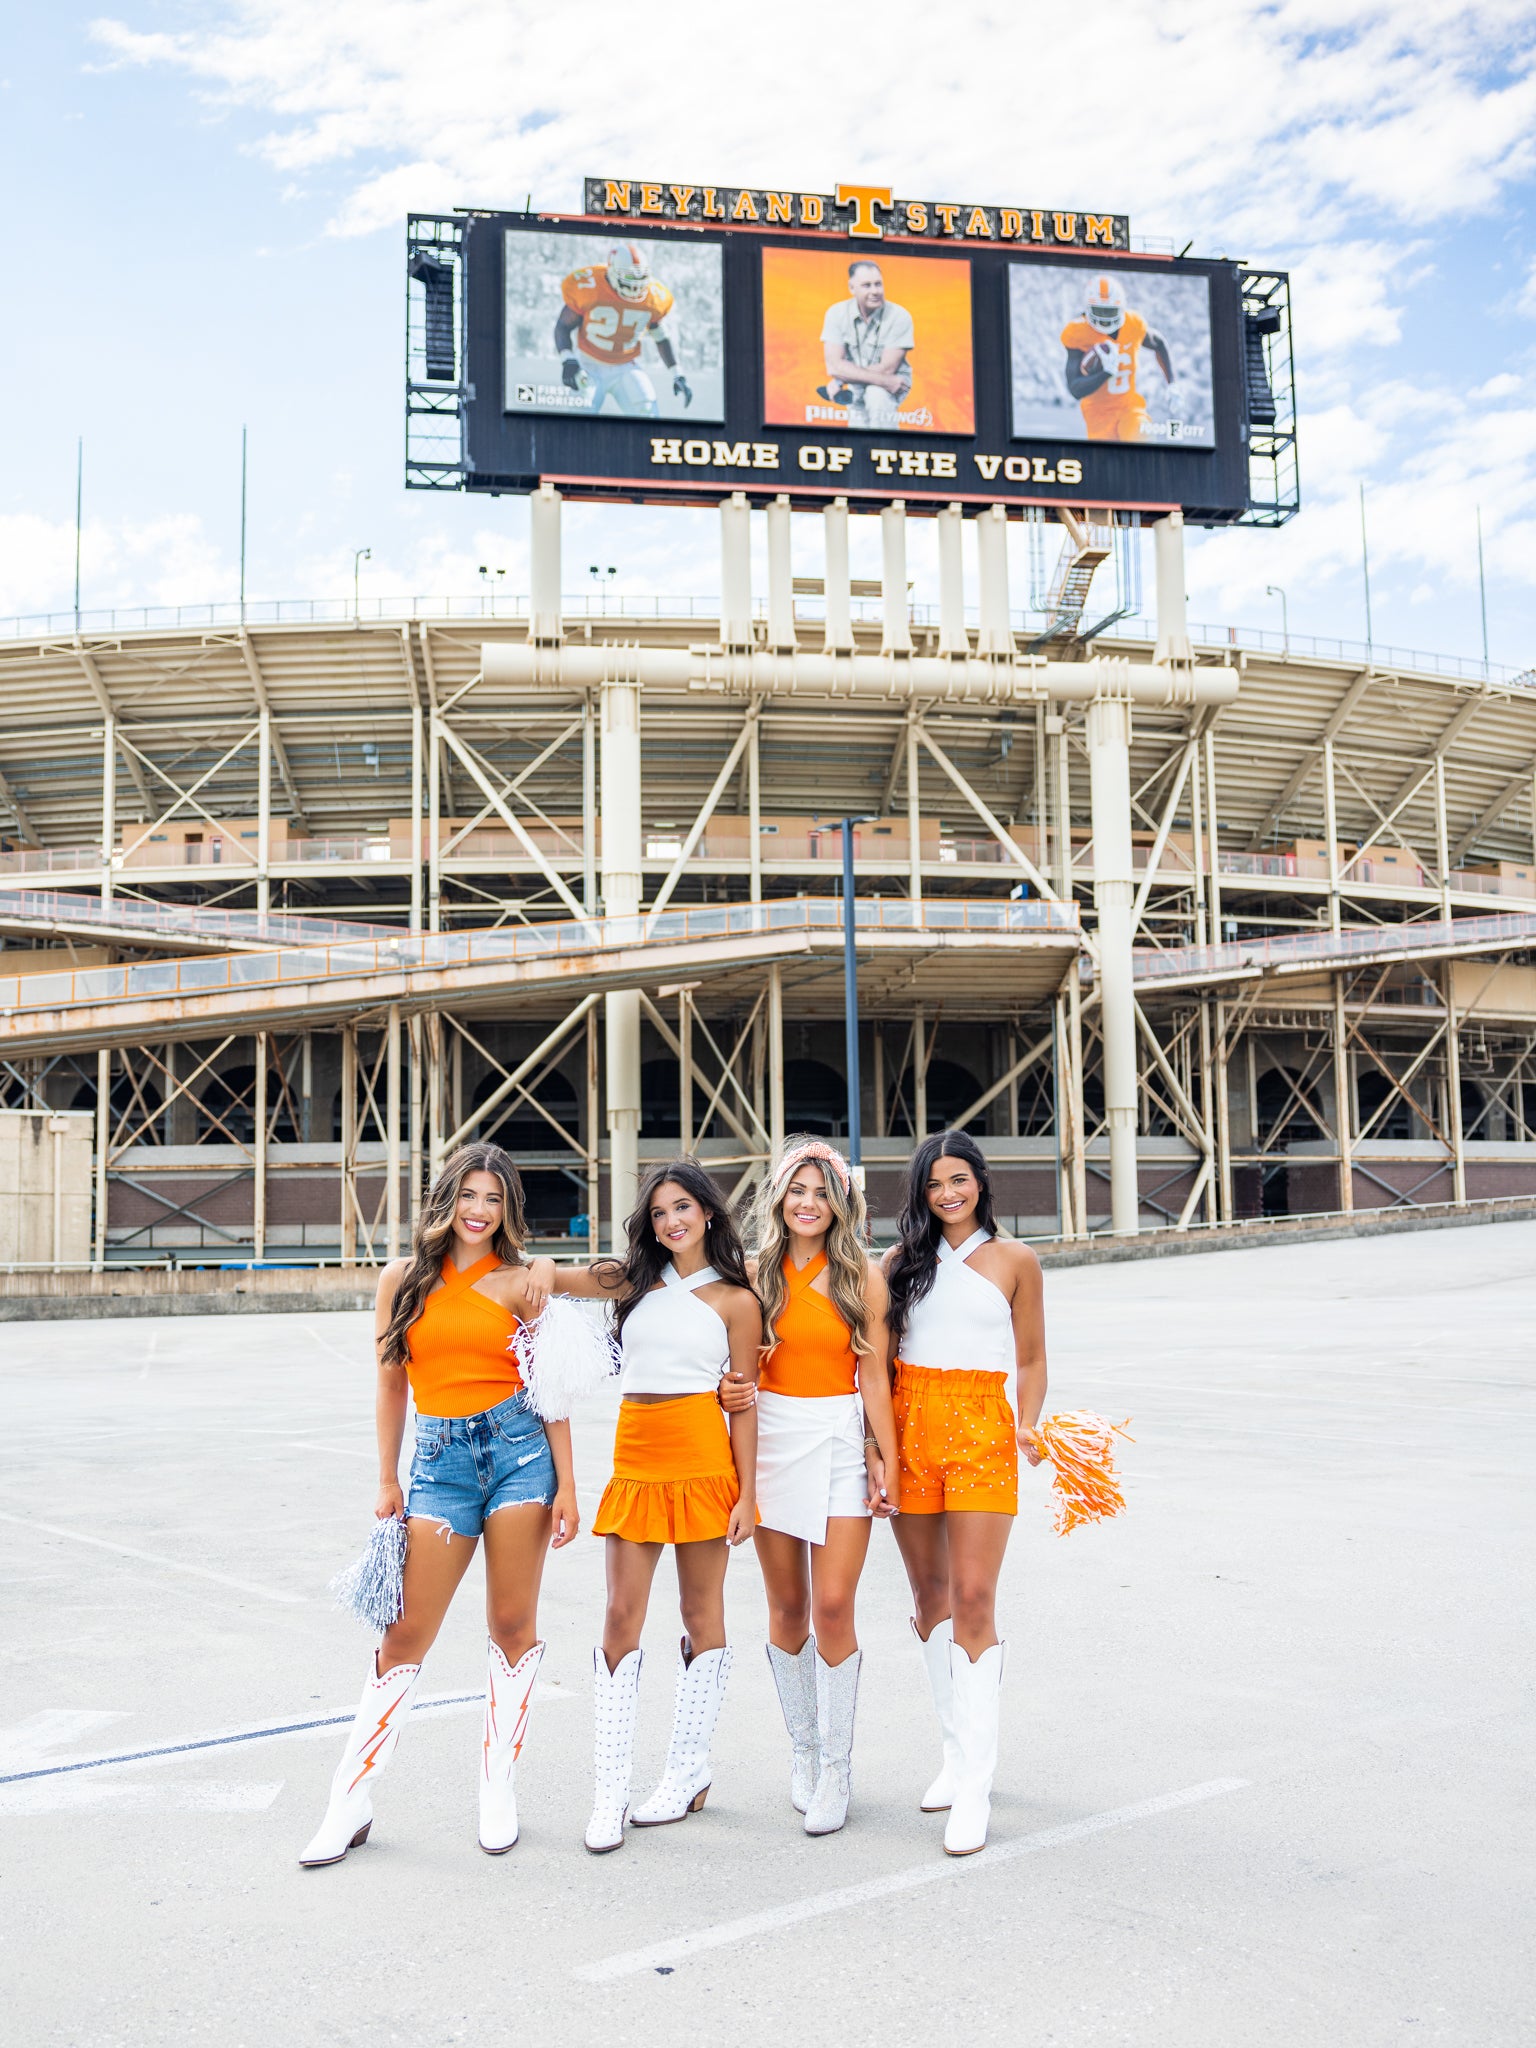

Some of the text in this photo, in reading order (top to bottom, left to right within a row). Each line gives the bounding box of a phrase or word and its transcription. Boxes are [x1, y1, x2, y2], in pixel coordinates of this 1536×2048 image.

[604, 181, 1114, 245] NEYLAND T STADIUM
[585, 305, 652, 352] 27
[650, 438, 1082, 485] HOME OF THE VOLS
